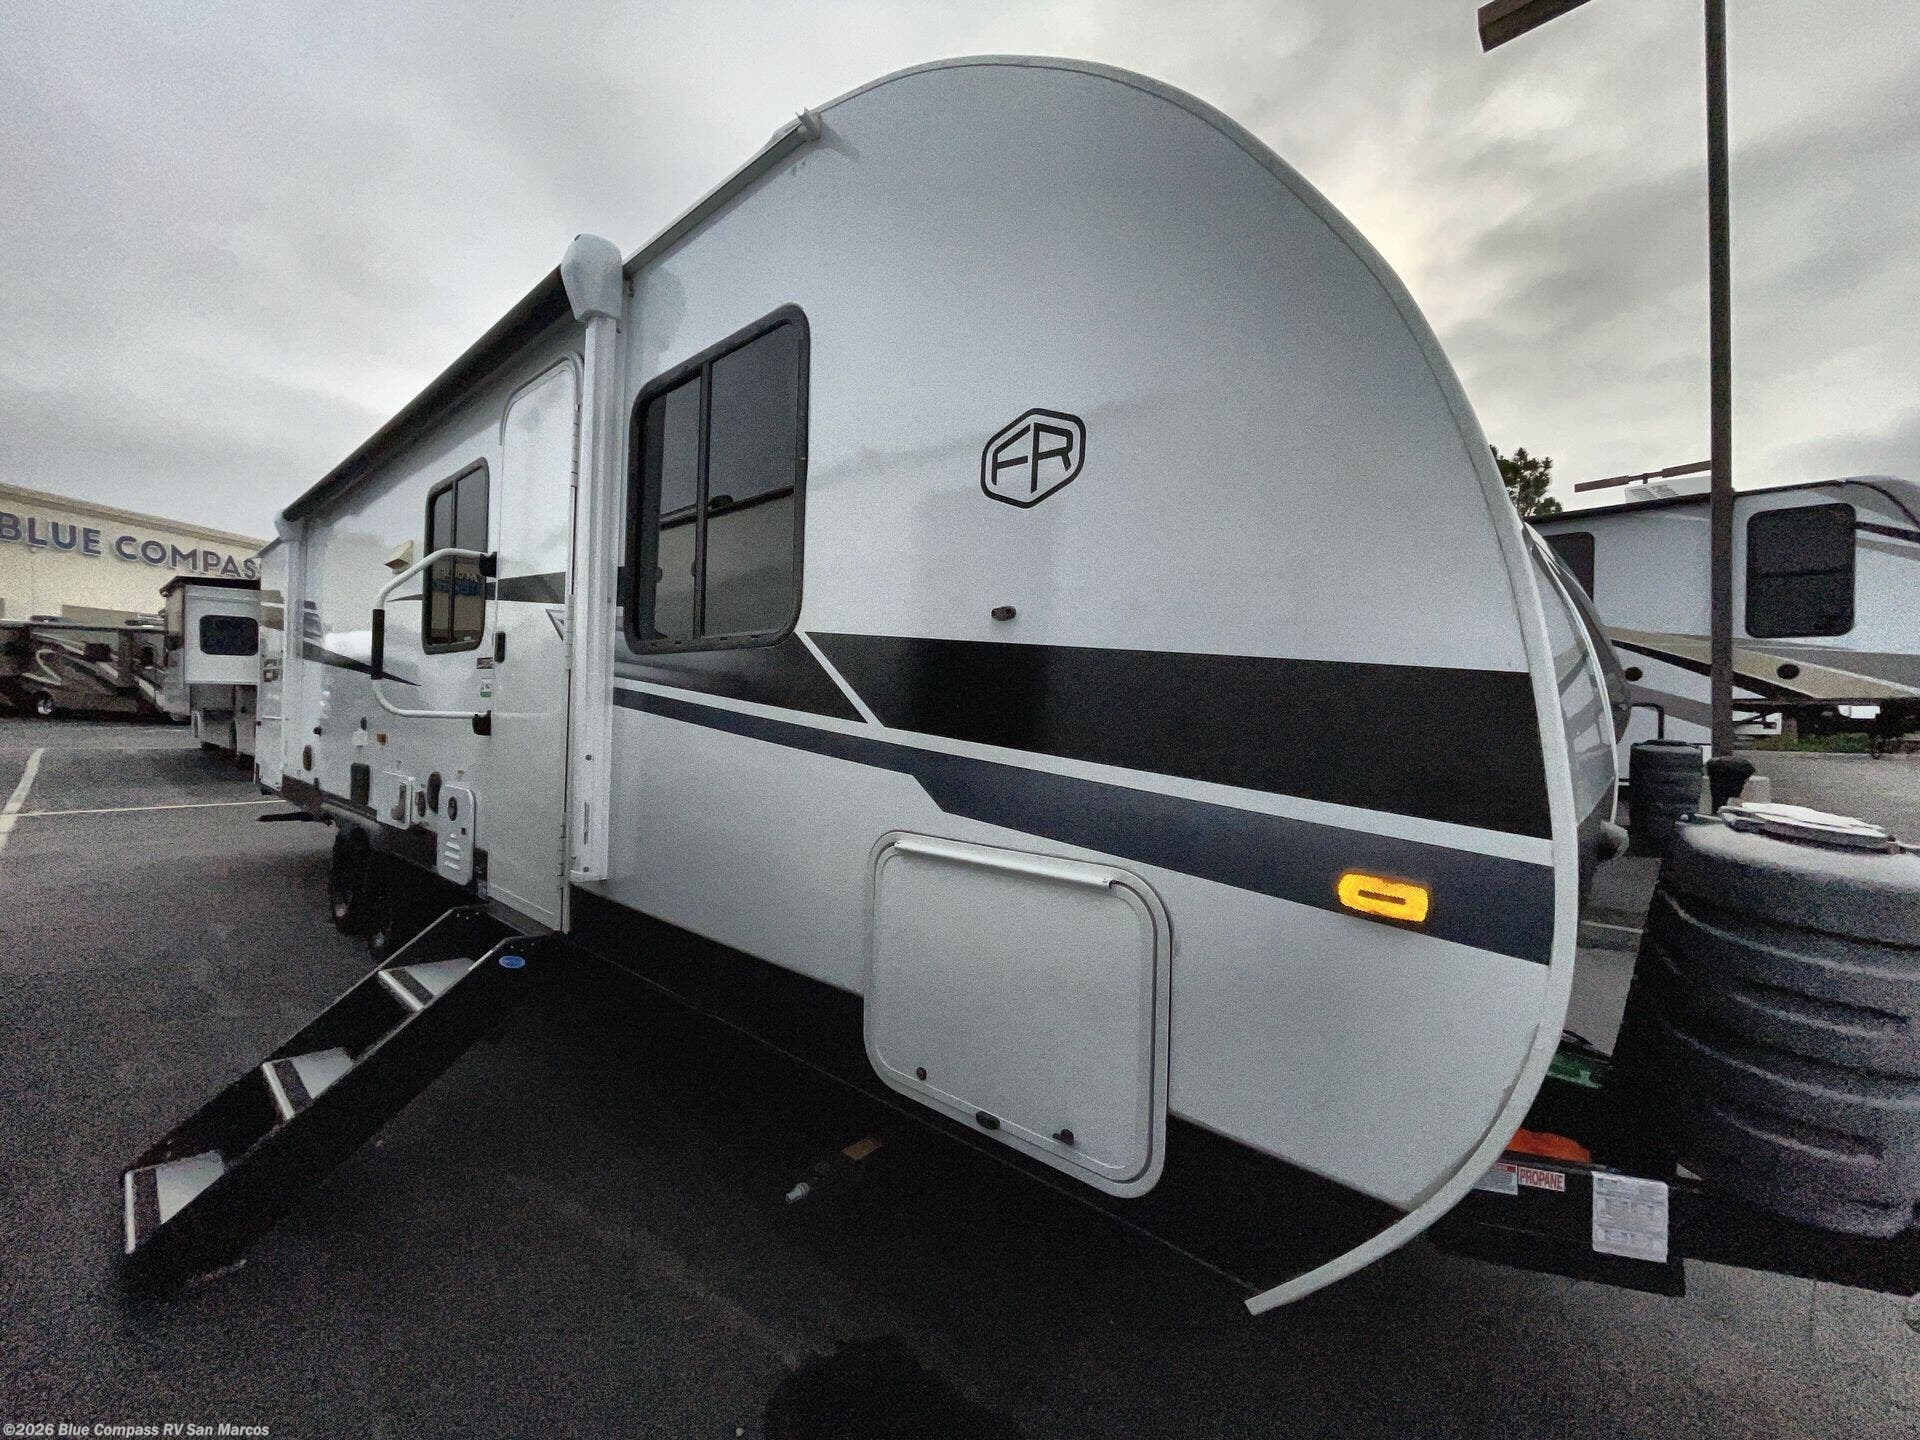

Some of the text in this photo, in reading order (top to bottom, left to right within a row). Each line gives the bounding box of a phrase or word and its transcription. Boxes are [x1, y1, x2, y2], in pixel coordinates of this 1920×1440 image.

[0, 511, 261, 580] BLUE COMPAS
[1520, 1169, 1563, 1190] PROPANE
